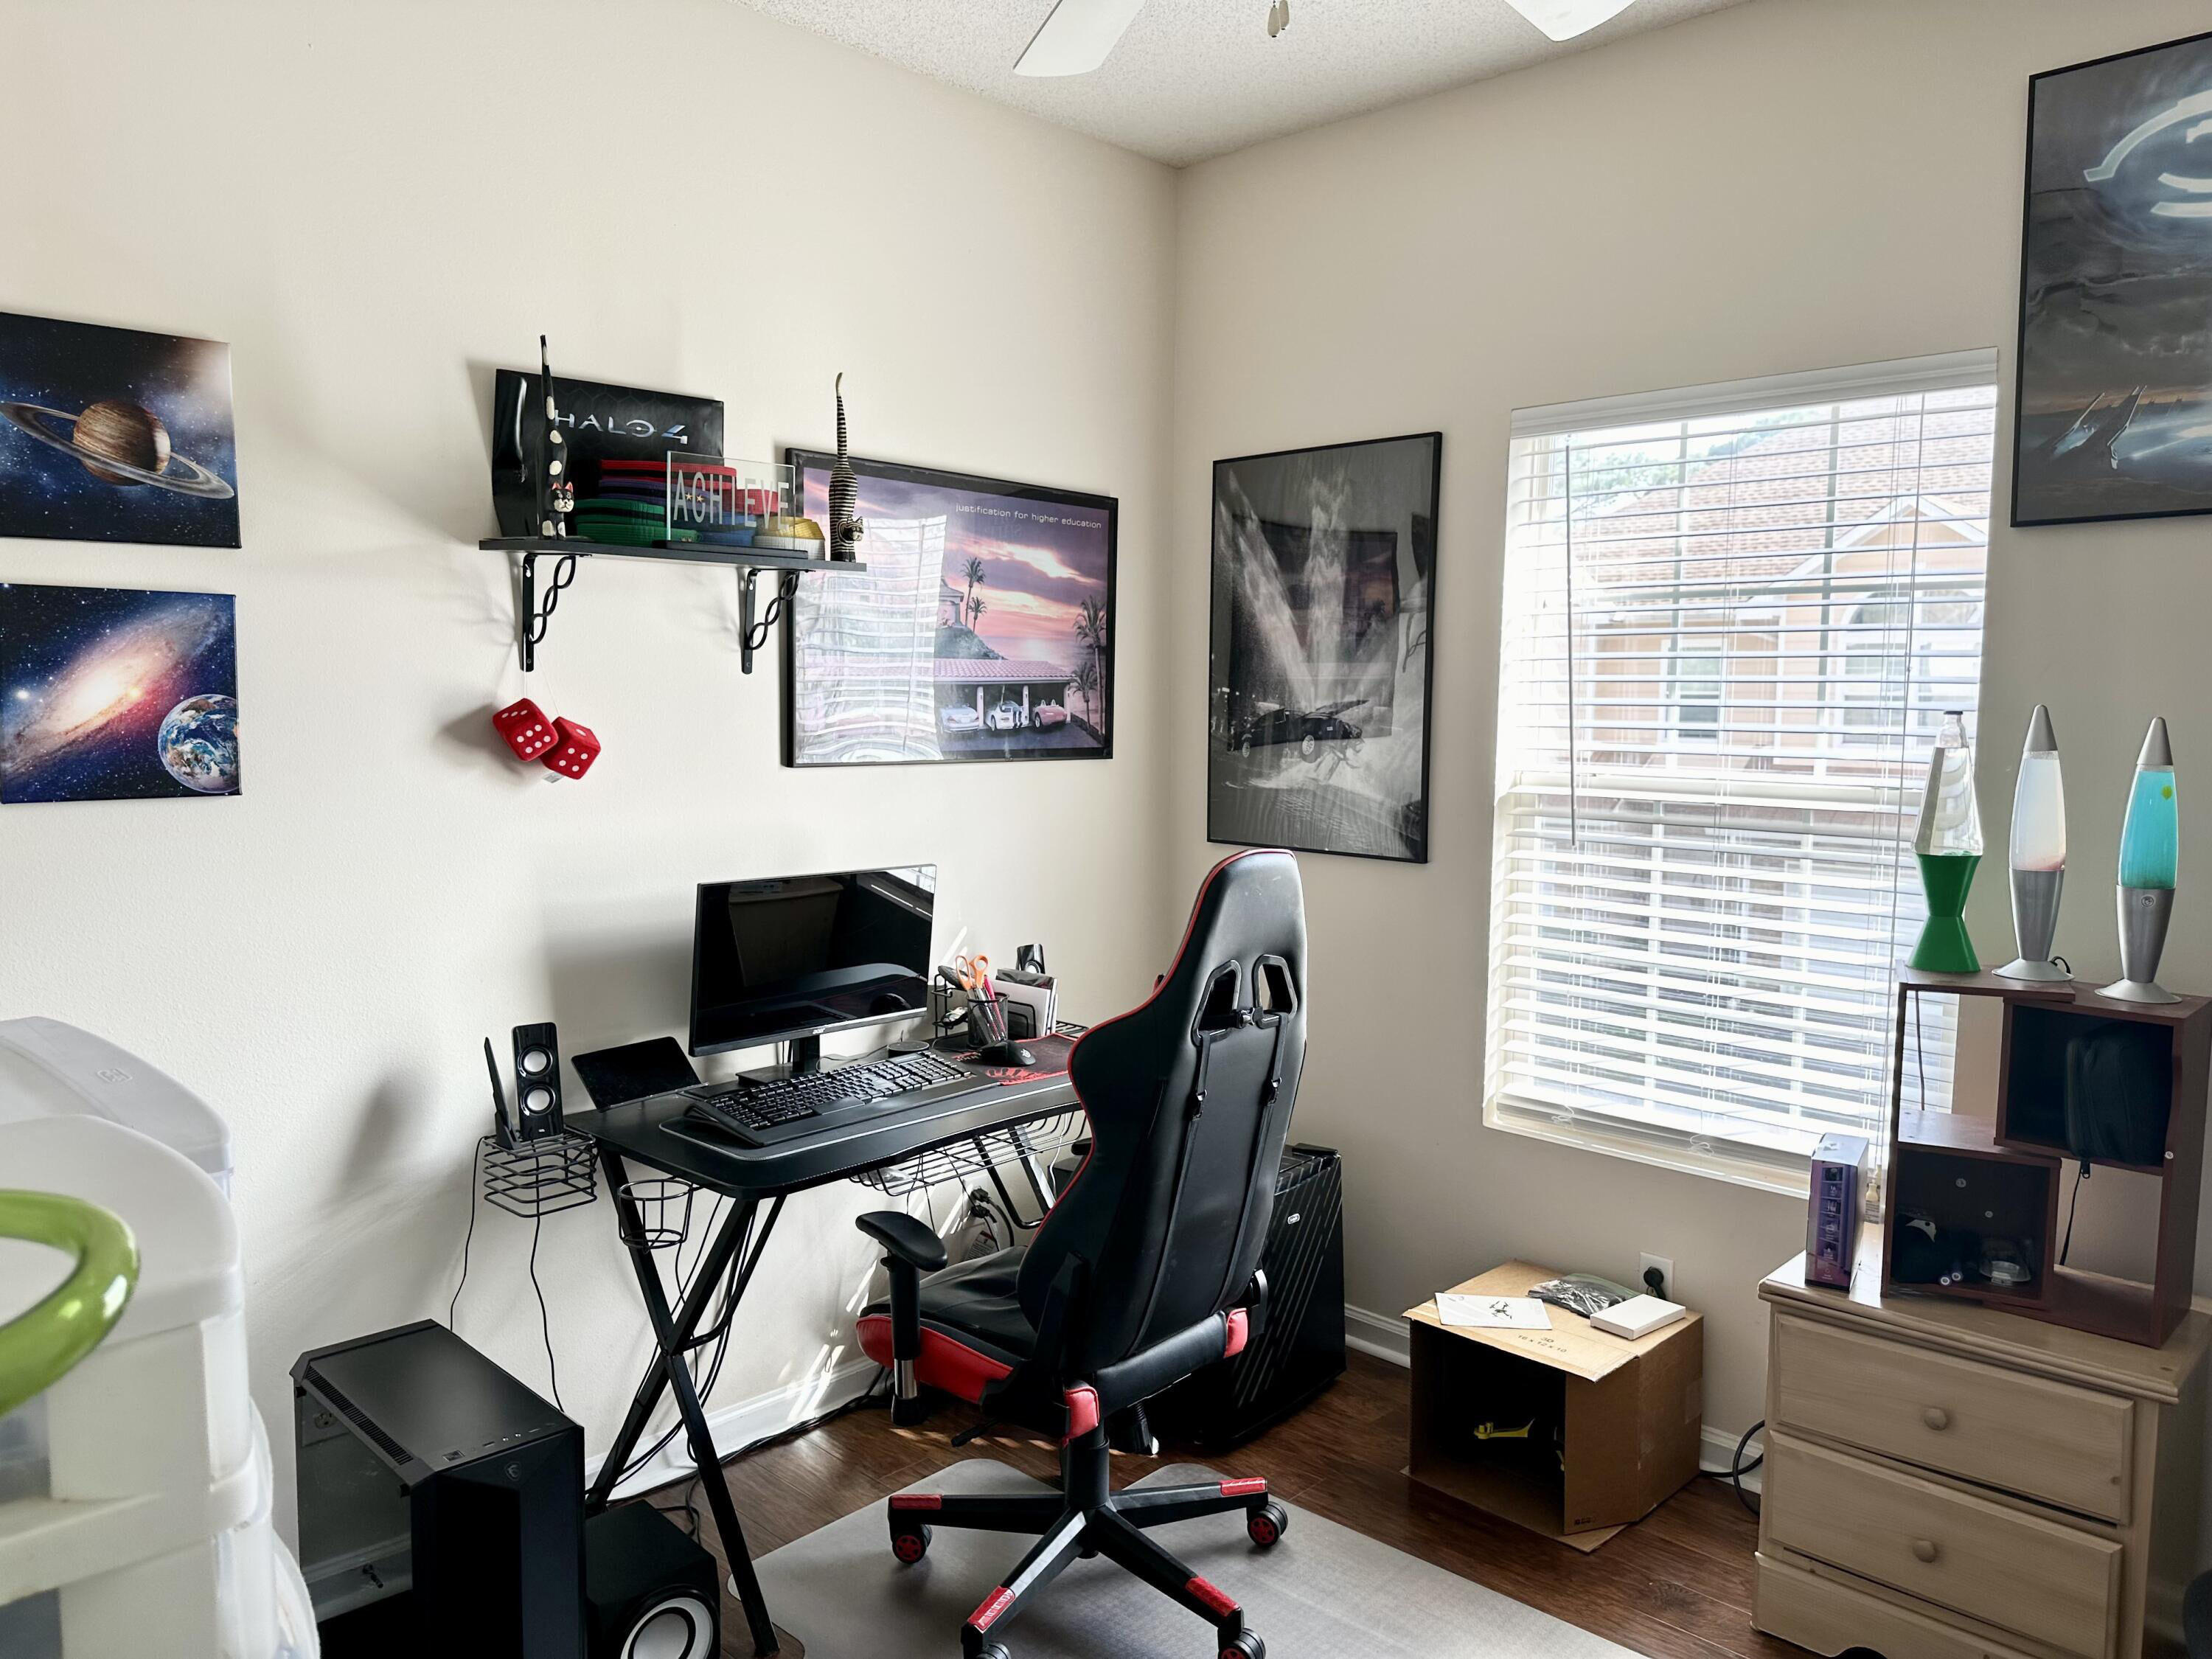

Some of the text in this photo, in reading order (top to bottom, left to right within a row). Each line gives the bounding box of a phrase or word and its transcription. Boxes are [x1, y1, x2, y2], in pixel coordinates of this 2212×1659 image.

[554, 409, 688, 445] HALO 4
[673, 470, 790, 531] ACHIEVE
[956, 504, 1102, 529] justification for higher education
